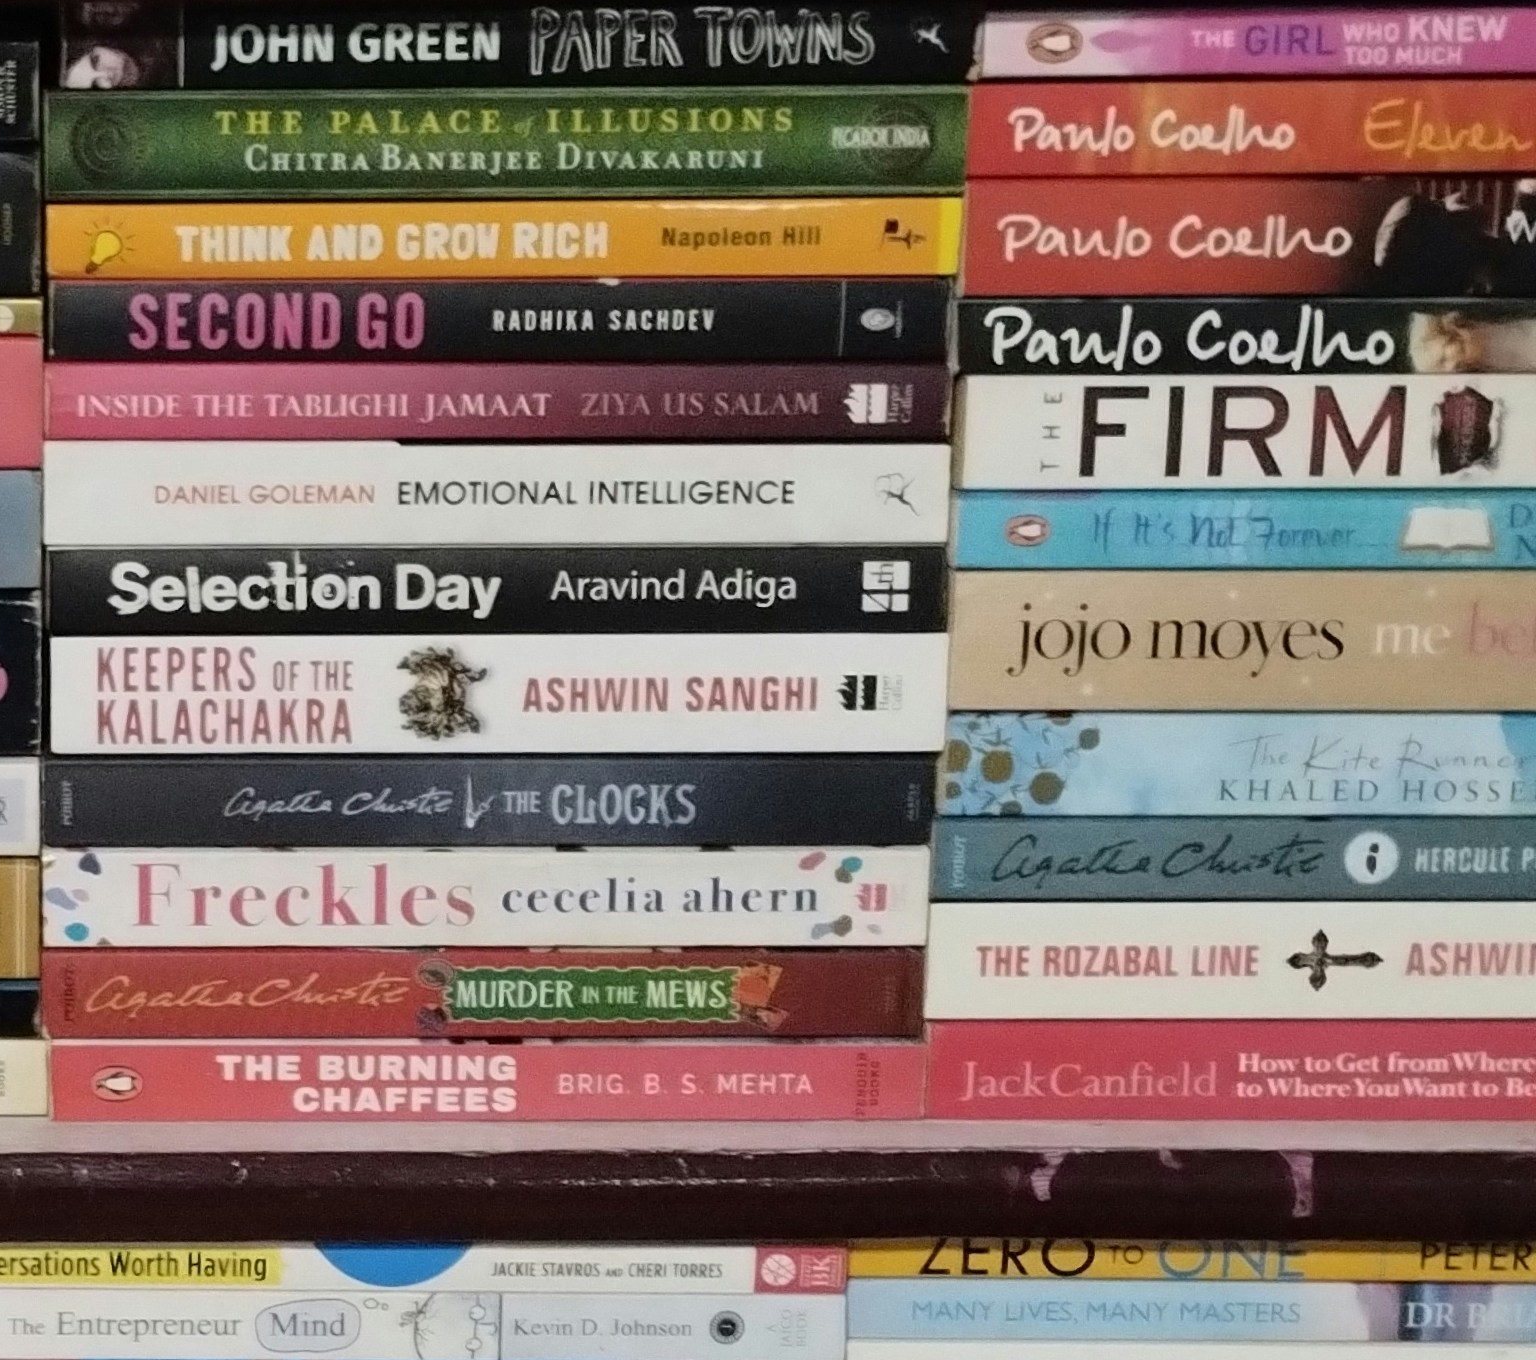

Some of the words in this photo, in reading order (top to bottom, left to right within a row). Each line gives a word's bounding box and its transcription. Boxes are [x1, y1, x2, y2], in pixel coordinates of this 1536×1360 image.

[210, 24, 335, 73] JOHN
[348, 21, 501, 63] GREEN
[176, 225, 292, 264] THINK
[305, 225, 384, 261] AND
[395, 223, 502, 260] GROW
[512, 222, 609, 258] RICH
[128, 292, 341, 351] SECOND
[356, 293, 426, 349] GO
[491, 310, 596, 333] RADHIKA
[609, 309, 716, 333] SACHDEV
[984, 306, 1162, 373] Paulo
[1186, 306, 1395, 373] Coelho
[1079, 385, 1408, 479] FIRM
[396, 479, 579, 507] EMOTIONAL
[587, 478, 797, 505] INTELLIGENCE
[107, 560, 382, 614] Selection
[395, 564, 502, 619] Day
[549, 569, 688, 604] Aravind
[695, 569, 798, 609] Adiga
[1007, 602, 1131, 679] jojo
[1149, 618, 1345, 679] moyes
[95, 647, 257, 693] KEEPERS
[272, 662, 303, 692] OF
[309, 662, 354, 692] THE
[522, 677, 669, 715] ASHWIN
[684, 676, 819, 713] SANGHI
[95, 698, 354, 746] KALACHAKRA
[133, 860, 478, 929] Freckles
[501, 875, 665, 916] cecelia
[682, 879, 819, 914] ahern
[977, 945, 1029, 978] THE
[1042, 944, 1178, 978] ROZABAL
[1191, 945, 1261, 978] LINE
[457, 979, 574, 1010] MURDER
[583, 985, 602, 1006] IN
[607, 984, 638, 1007] THE
[646, 979, 728, 1009] MEWS
[216, 1055, 301, 1084] THE
[317, 1054, 518, 1084] BURNING
[291, 1085, 518, 1115] CHAFFEES
[108, 1251, 179, 1278] Worth
[186, 1251, 268, 1282] Having
[56, 1310, 241, 1341] Entrepreneur
